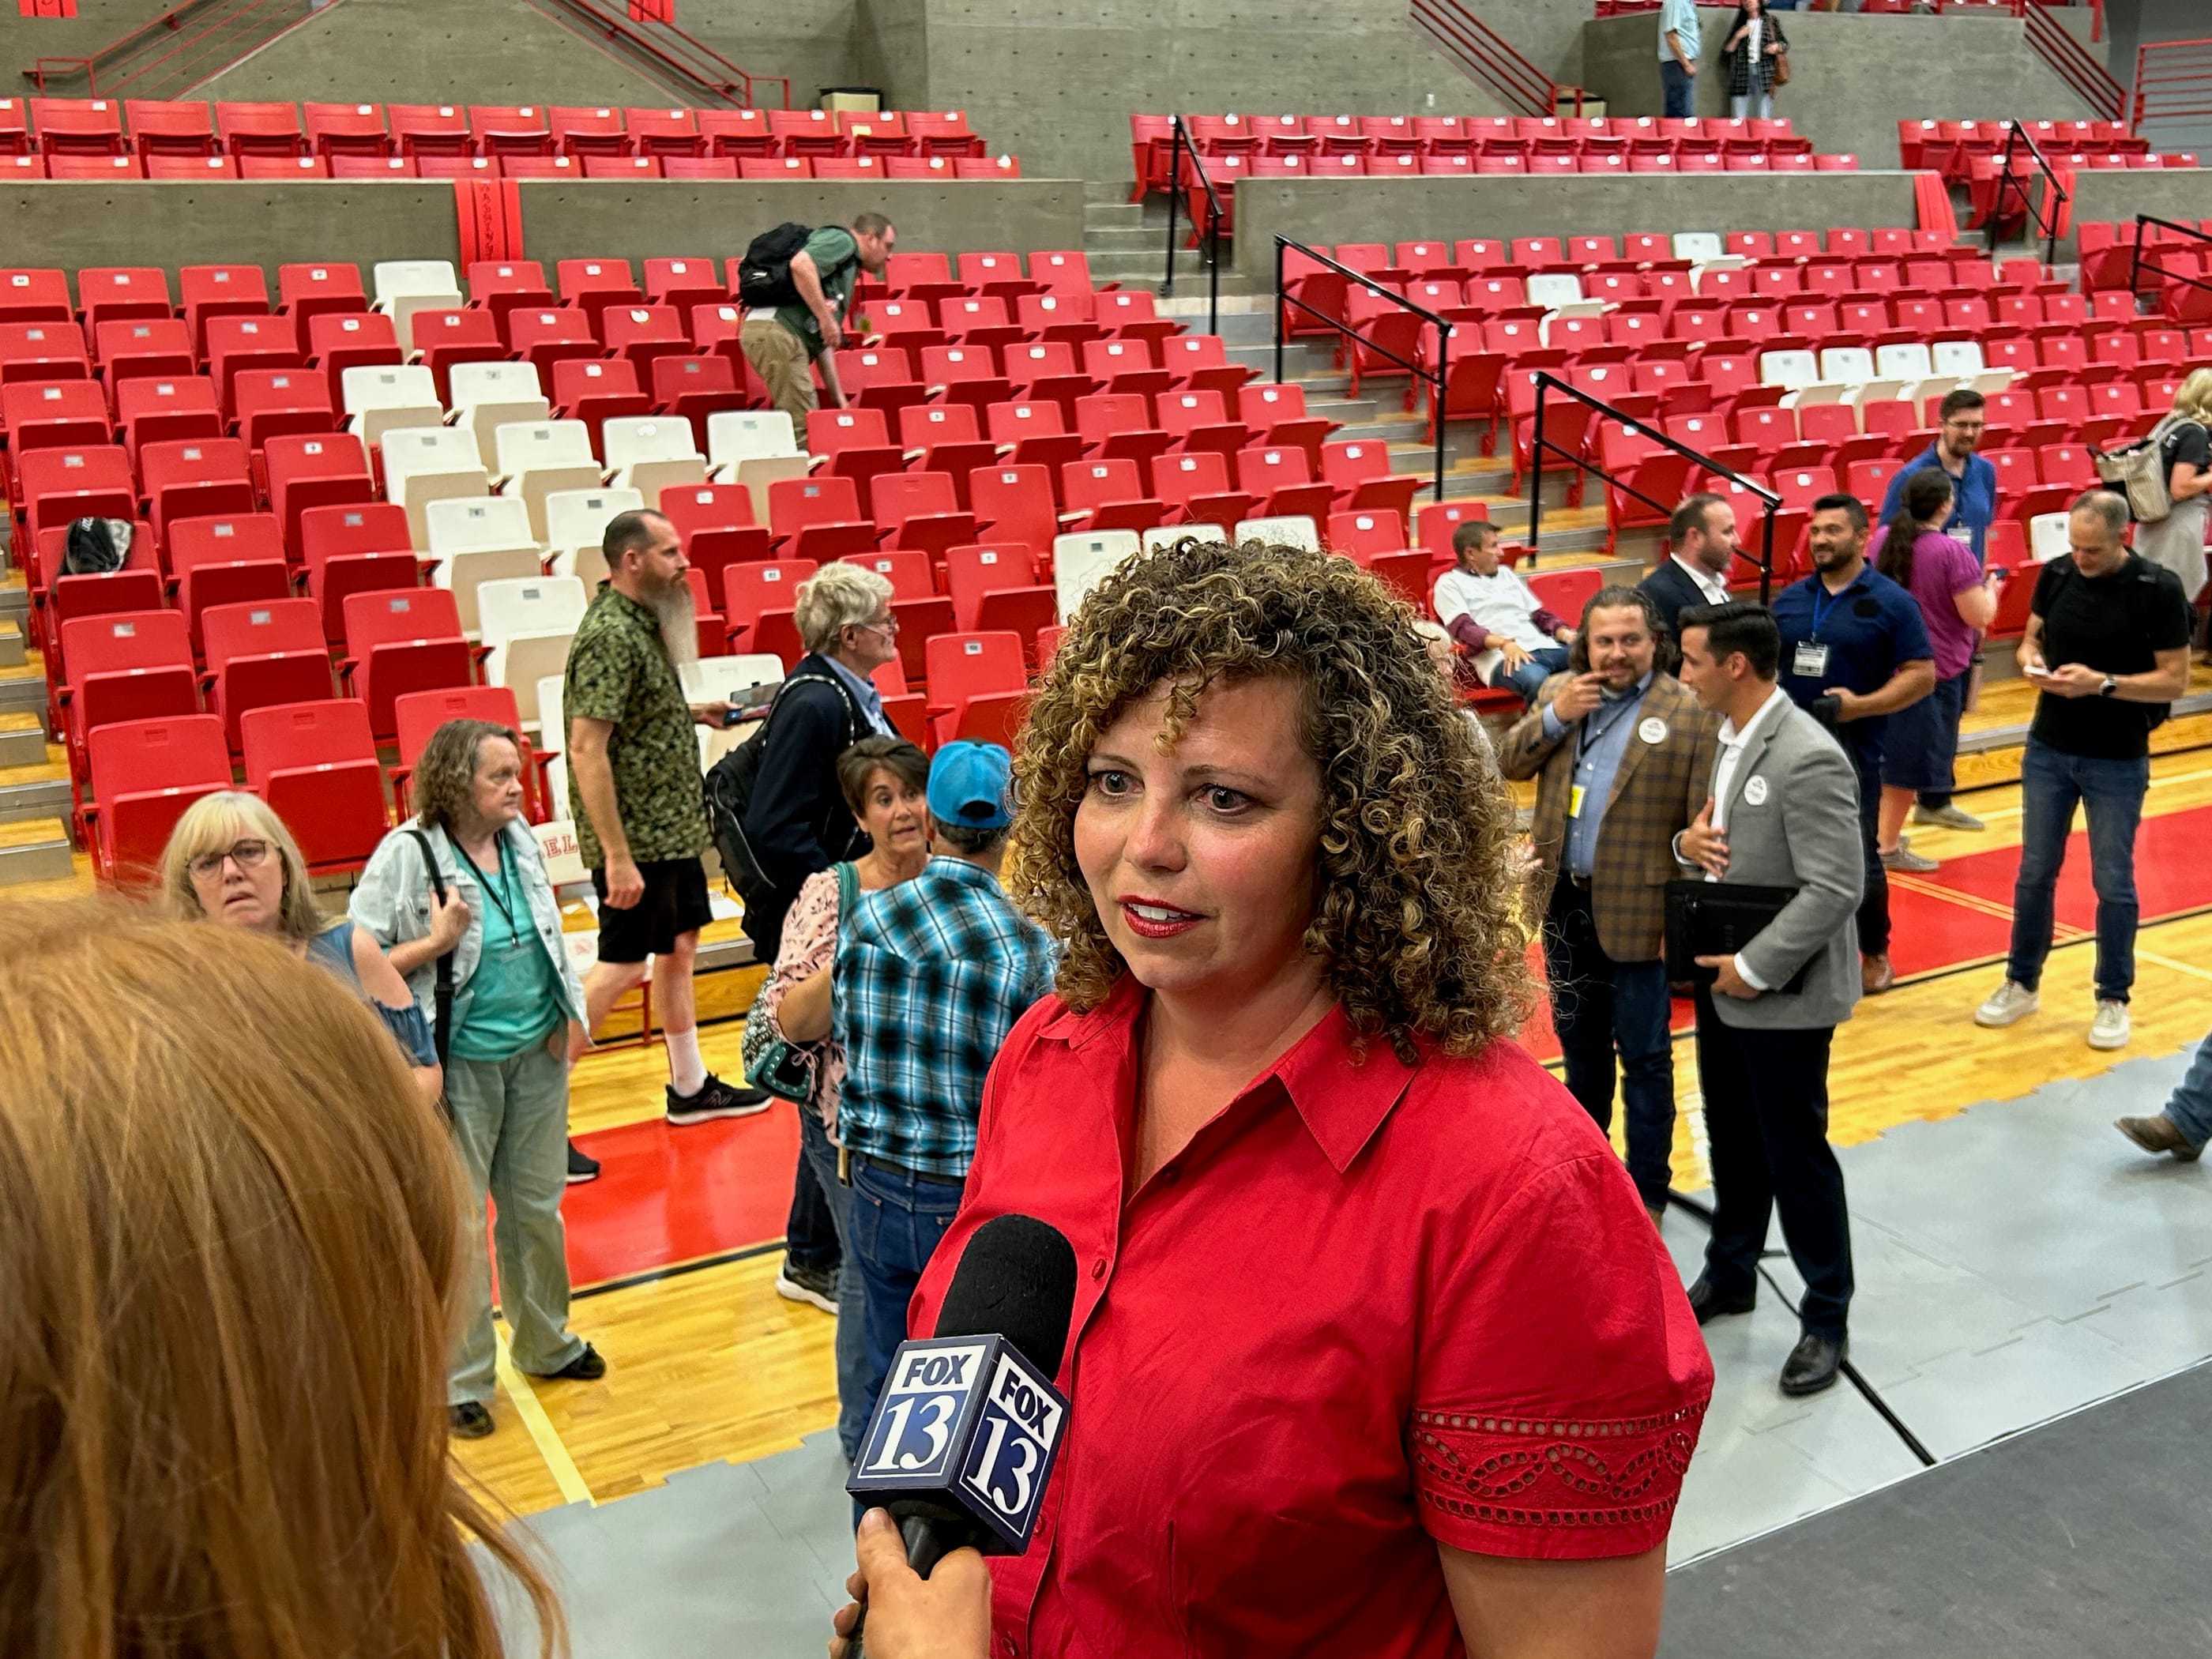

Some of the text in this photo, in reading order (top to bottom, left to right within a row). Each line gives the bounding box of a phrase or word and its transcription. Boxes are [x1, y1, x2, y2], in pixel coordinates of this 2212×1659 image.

[542, 834, 578, 859] EL
[903, 1353, 972, 1388] FOX
[999, 1367, 1053, 1439] FOX
[866, 1394, 956, 1470] 13
[966, 1416, 1039, 1515] 13
